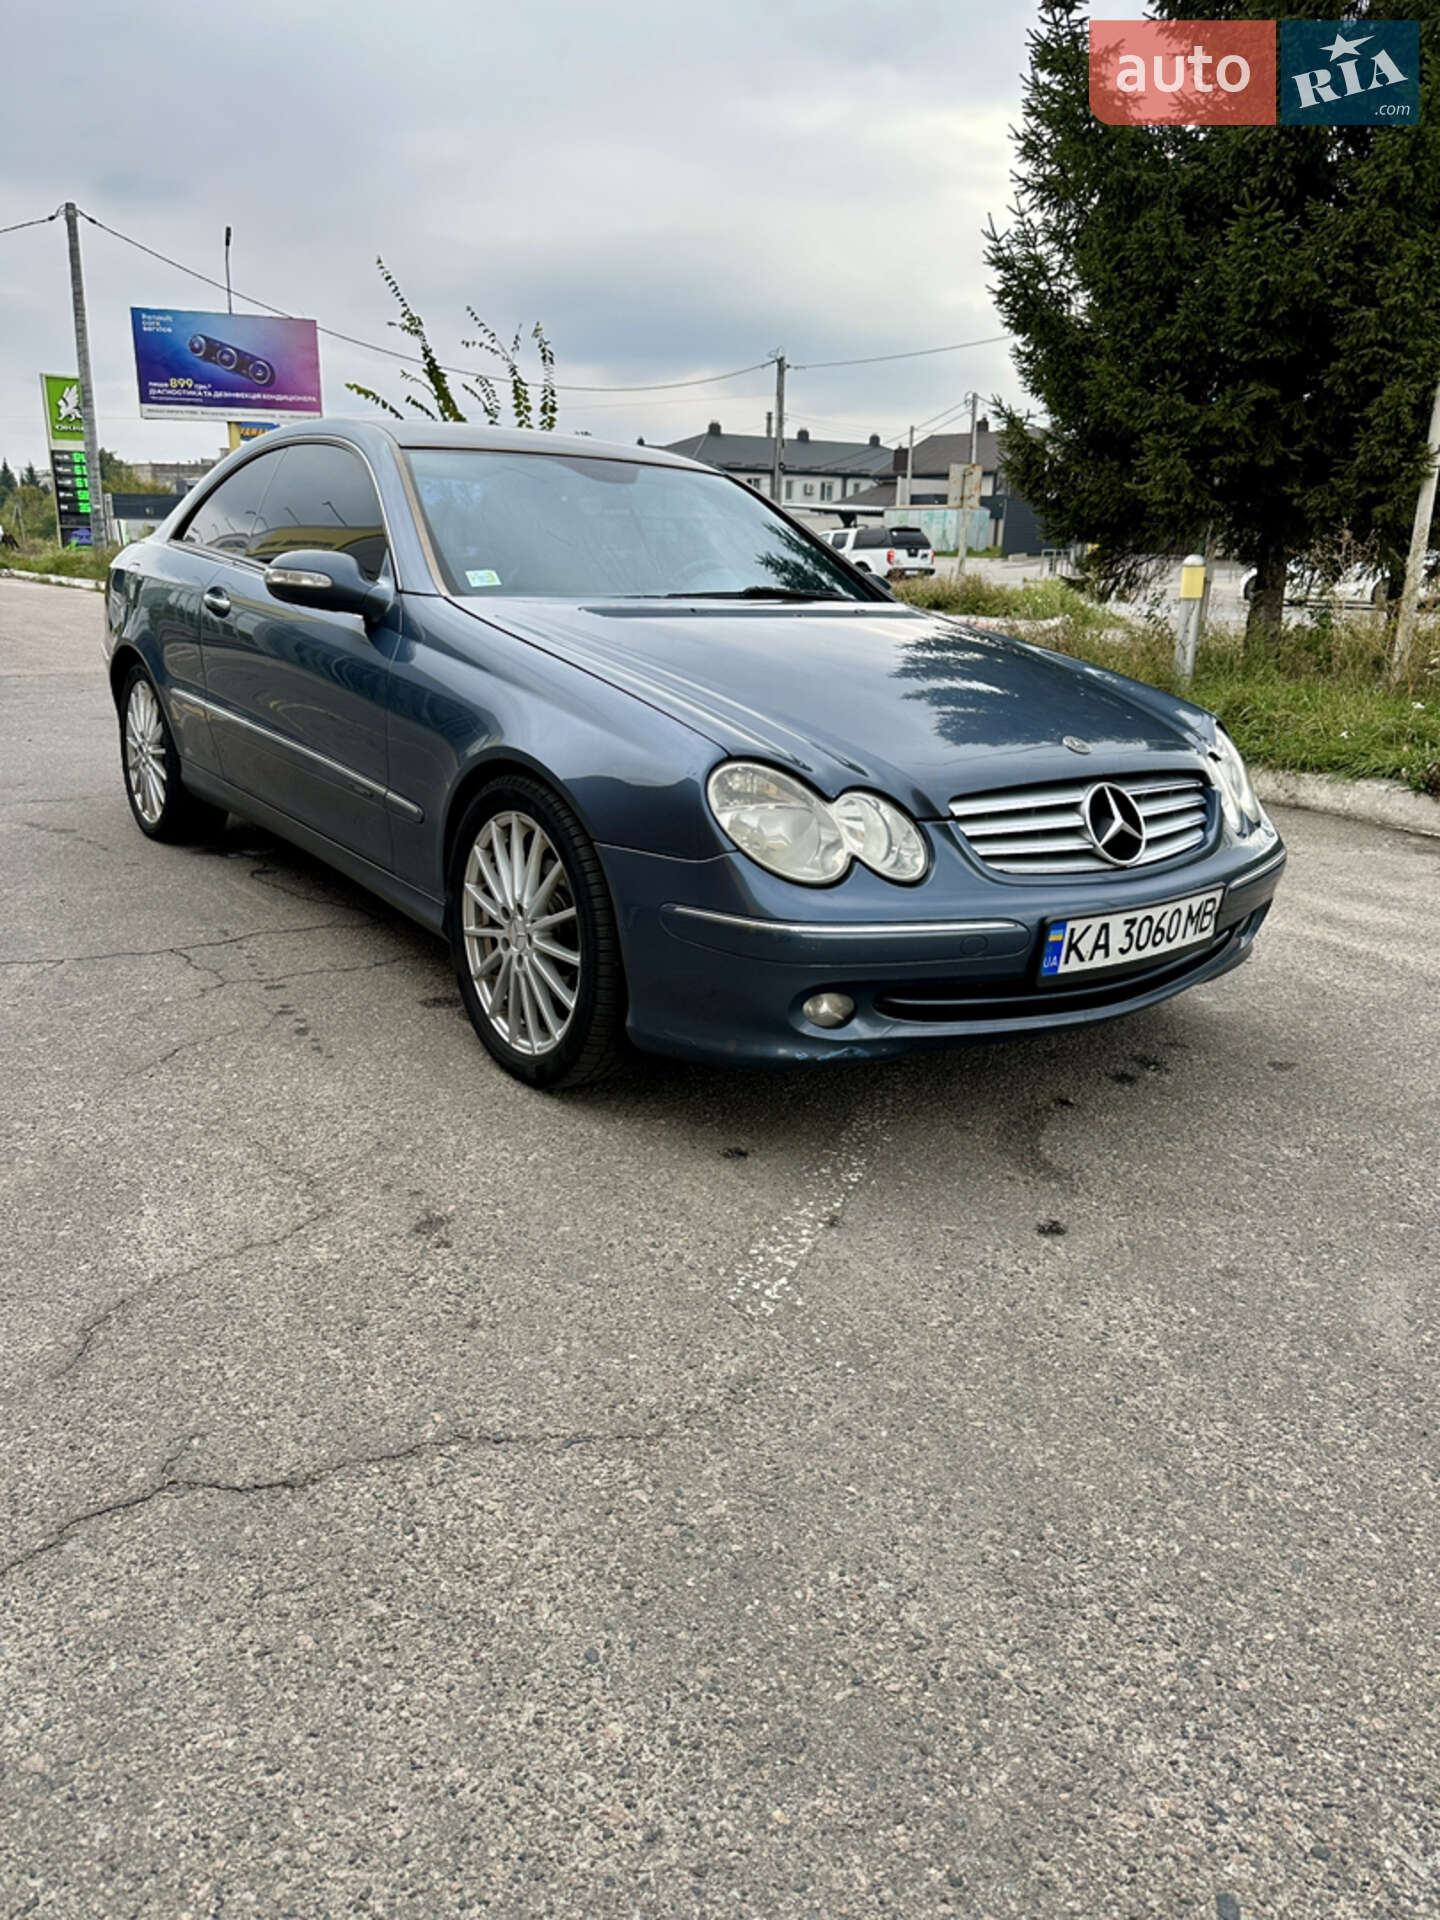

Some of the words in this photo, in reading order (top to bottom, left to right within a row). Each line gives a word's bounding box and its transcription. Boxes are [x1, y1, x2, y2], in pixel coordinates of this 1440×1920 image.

[169, 377, 194, 388] 899
[1063, 922, 1111, 965] KA
[1118, 908, 1181, 956] 3060
[1182, 897, 1218, 939] MB
[1042, 955, 1058, 968] UA
